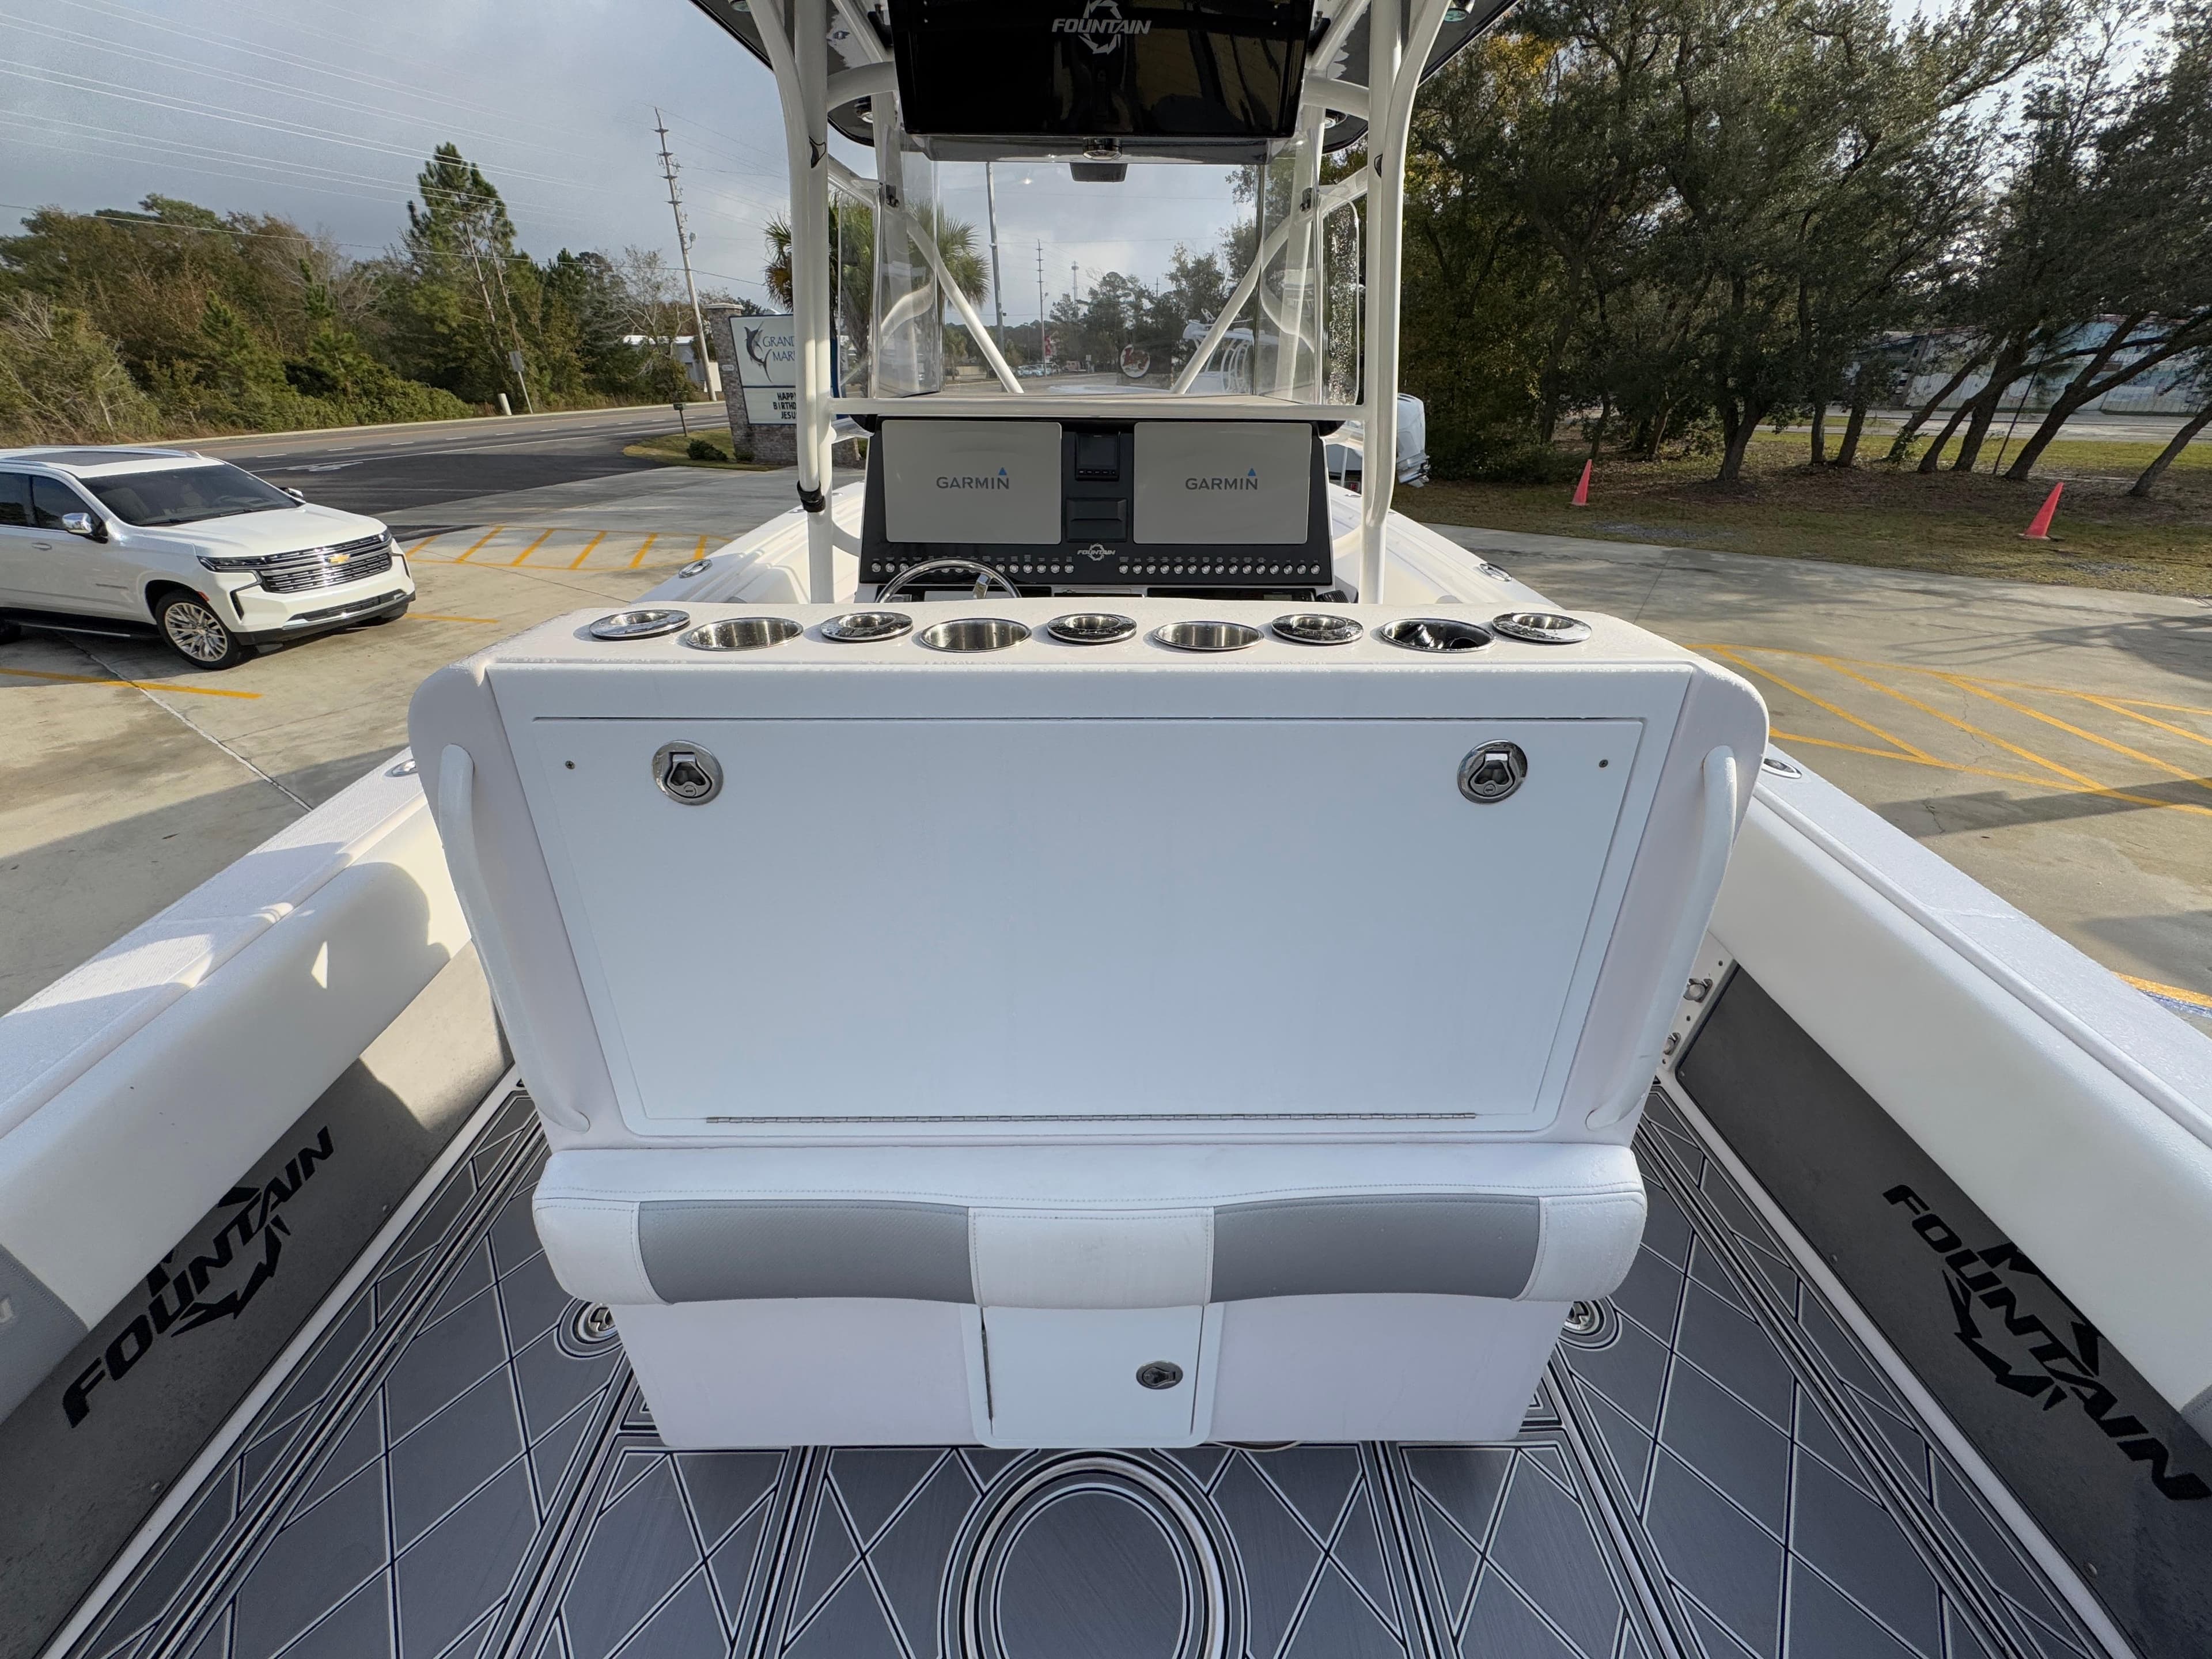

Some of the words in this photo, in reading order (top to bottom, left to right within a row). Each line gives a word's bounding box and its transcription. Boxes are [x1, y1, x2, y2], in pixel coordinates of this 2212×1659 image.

[1051, 18, 1152, 35] FOUNTAIN
[781, 411, 797, 419] JESU
[935, 476, 1010, 490] GARMIN
[1185, 478, 1259, 490] GARMIN
[62, 1125, 334, 1429] FOUNTAIN
[1882, 1184, 2212, 1501] FOUNTAIN
